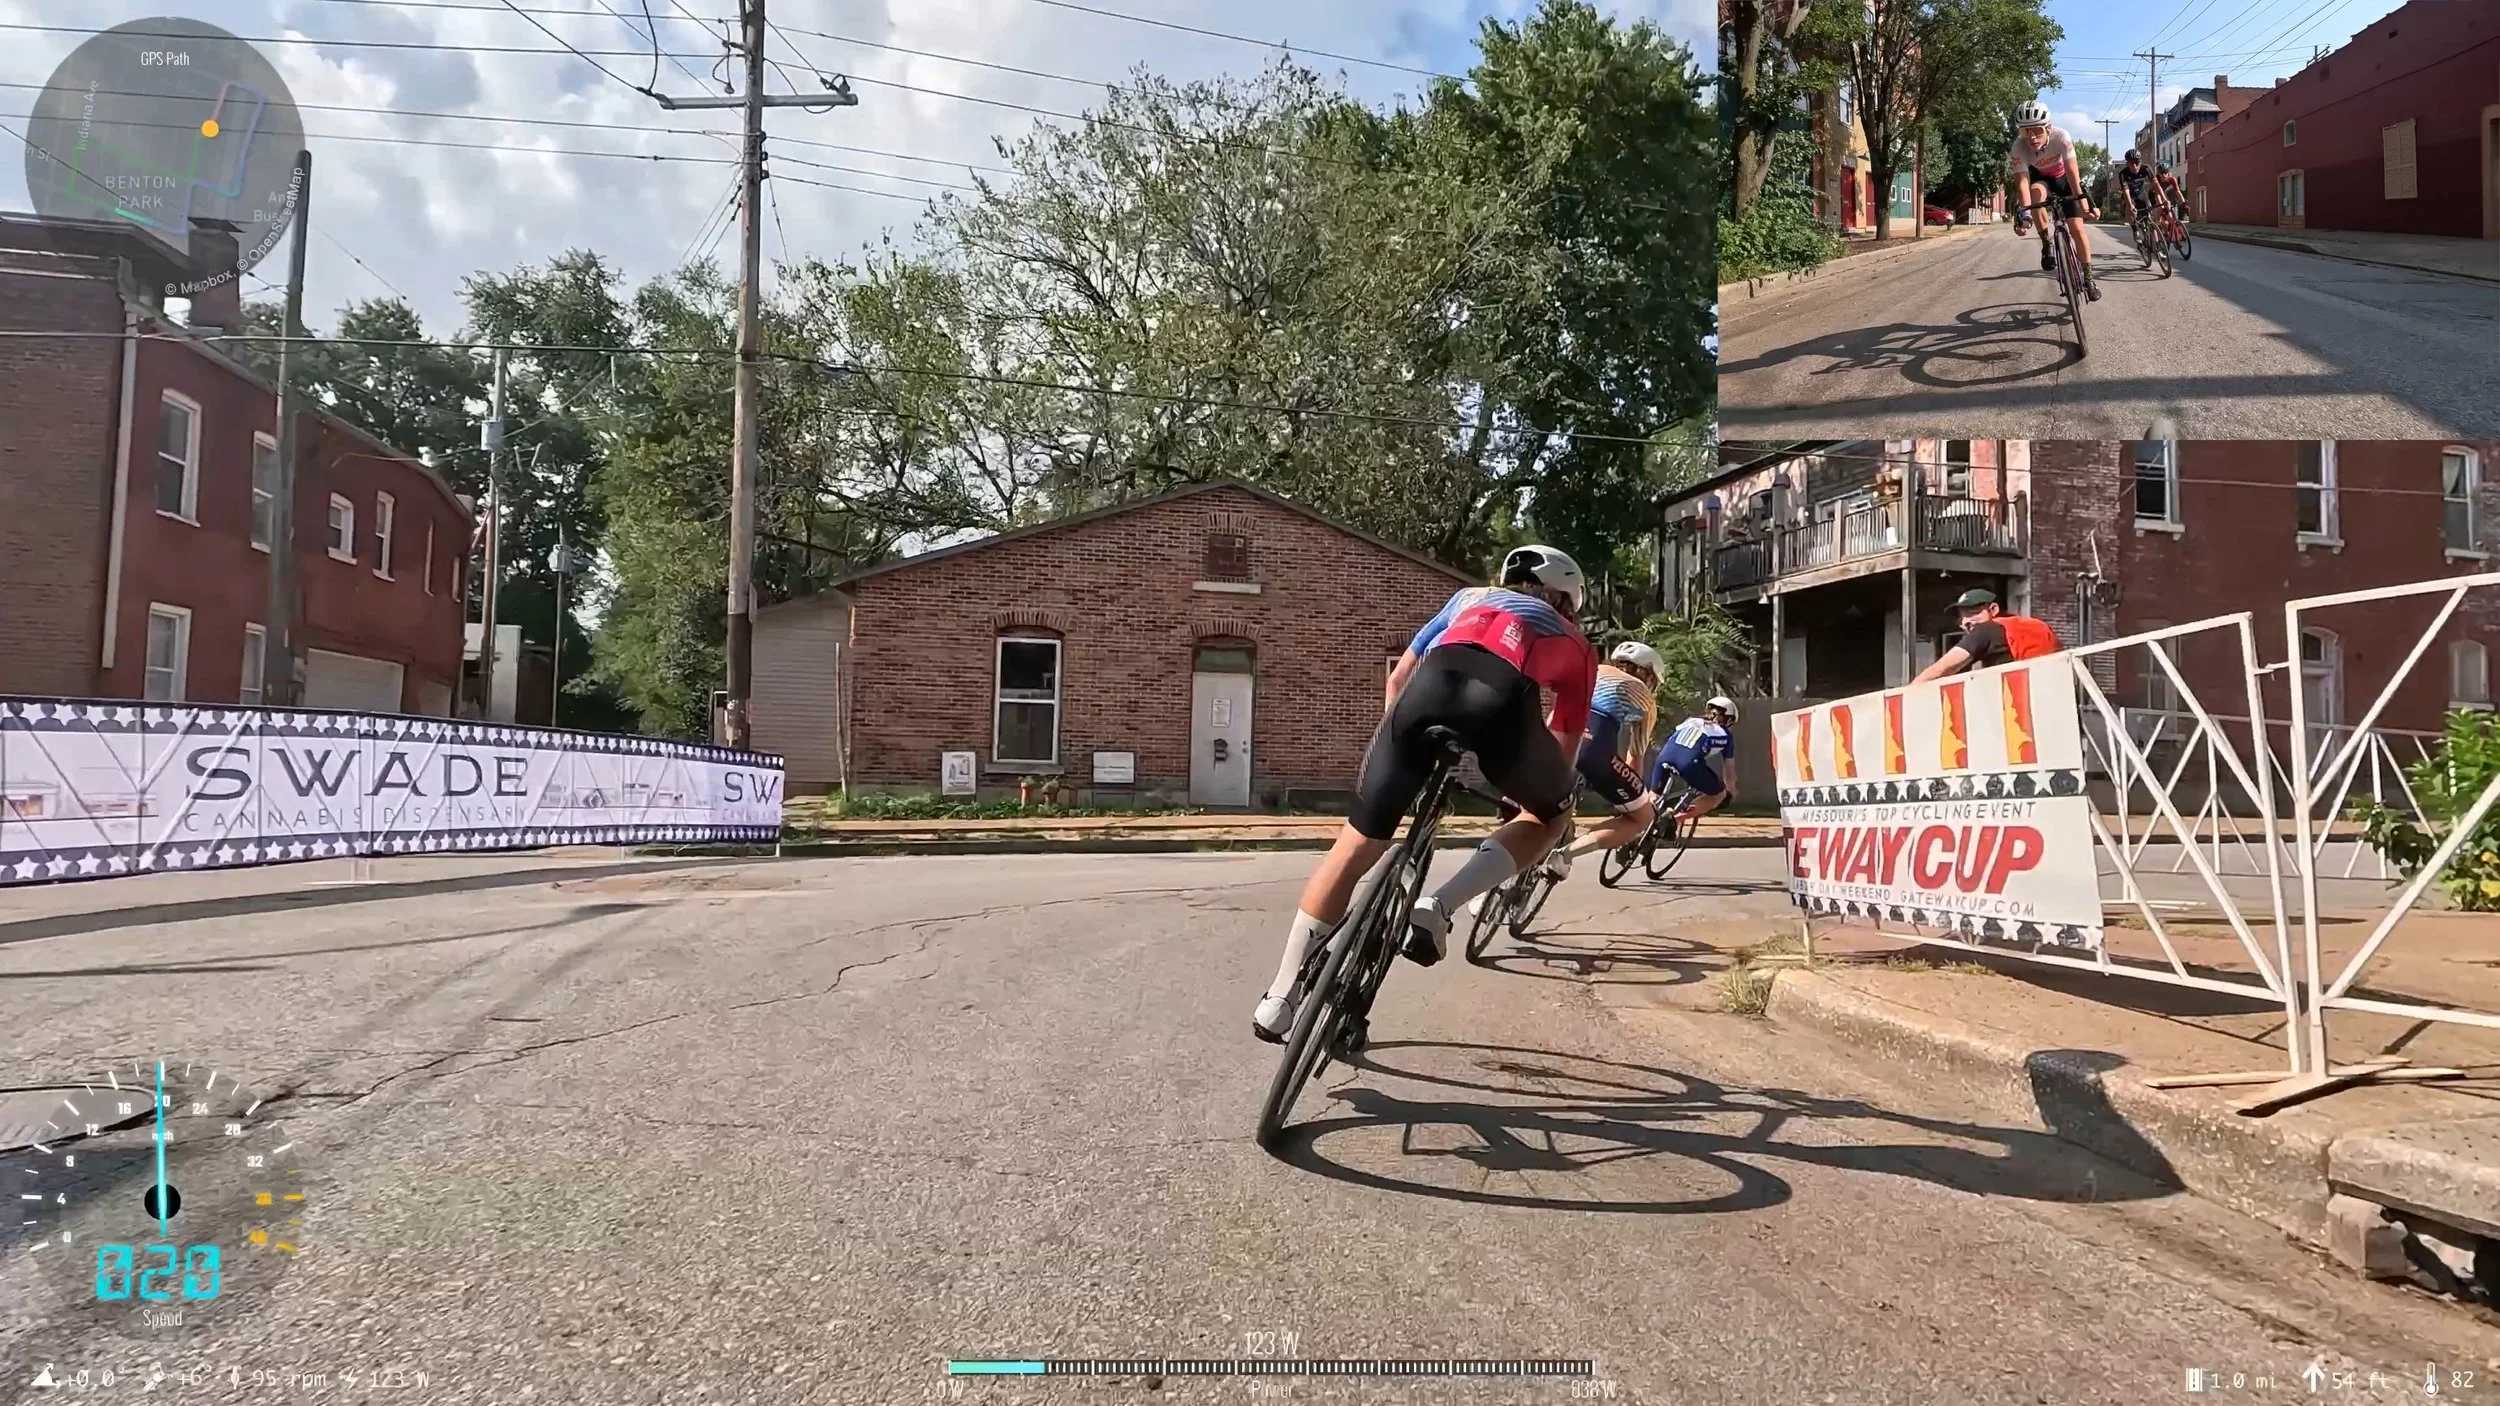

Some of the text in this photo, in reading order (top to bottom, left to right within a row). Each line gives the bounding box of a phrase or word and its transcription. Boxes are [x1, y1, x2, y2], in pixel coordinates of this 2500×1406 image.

[186, 745, 529, 801] SWADE
[724, 771, 779, 806] SW
[184, 807, 363, 832] CANNABIS
[1875, 806, 1898, 821] TOP
[1903, 803, 1974, 821] CYCLING
[1976, 801, 2036, 818] EVENT
[1913, 824, 2044, 895] CUP
